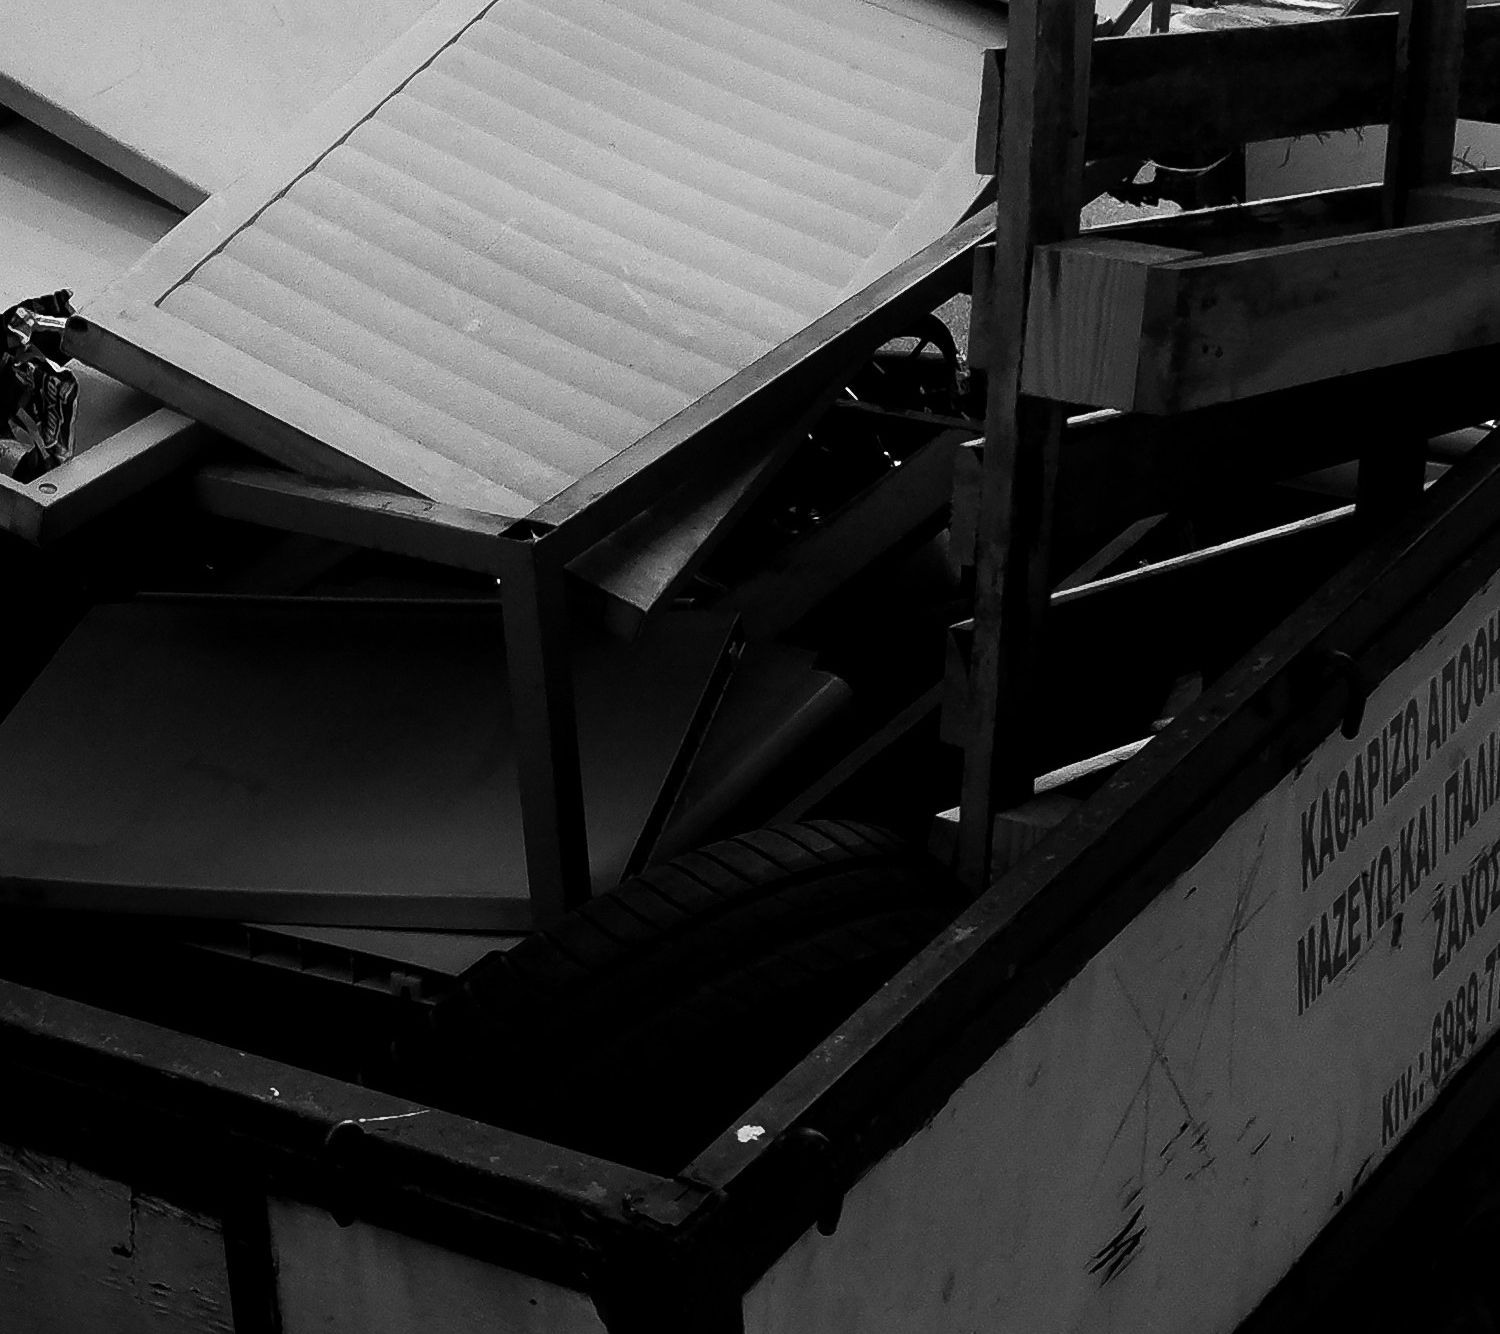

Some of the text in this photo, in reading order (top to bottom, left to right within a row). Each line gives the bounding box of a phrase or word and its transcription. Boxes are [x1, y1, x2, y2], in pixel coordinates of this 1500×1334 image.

[1302, 699, 1420, 892] ΚΑΘΑΡΙΖΩ
[1298, 845, 1393, 1016] ΜΑΖΕΥΩ
[1400, 794, 1437, 904] ΚΑΙ
[1431, 971, 1479, 1089] 6989
